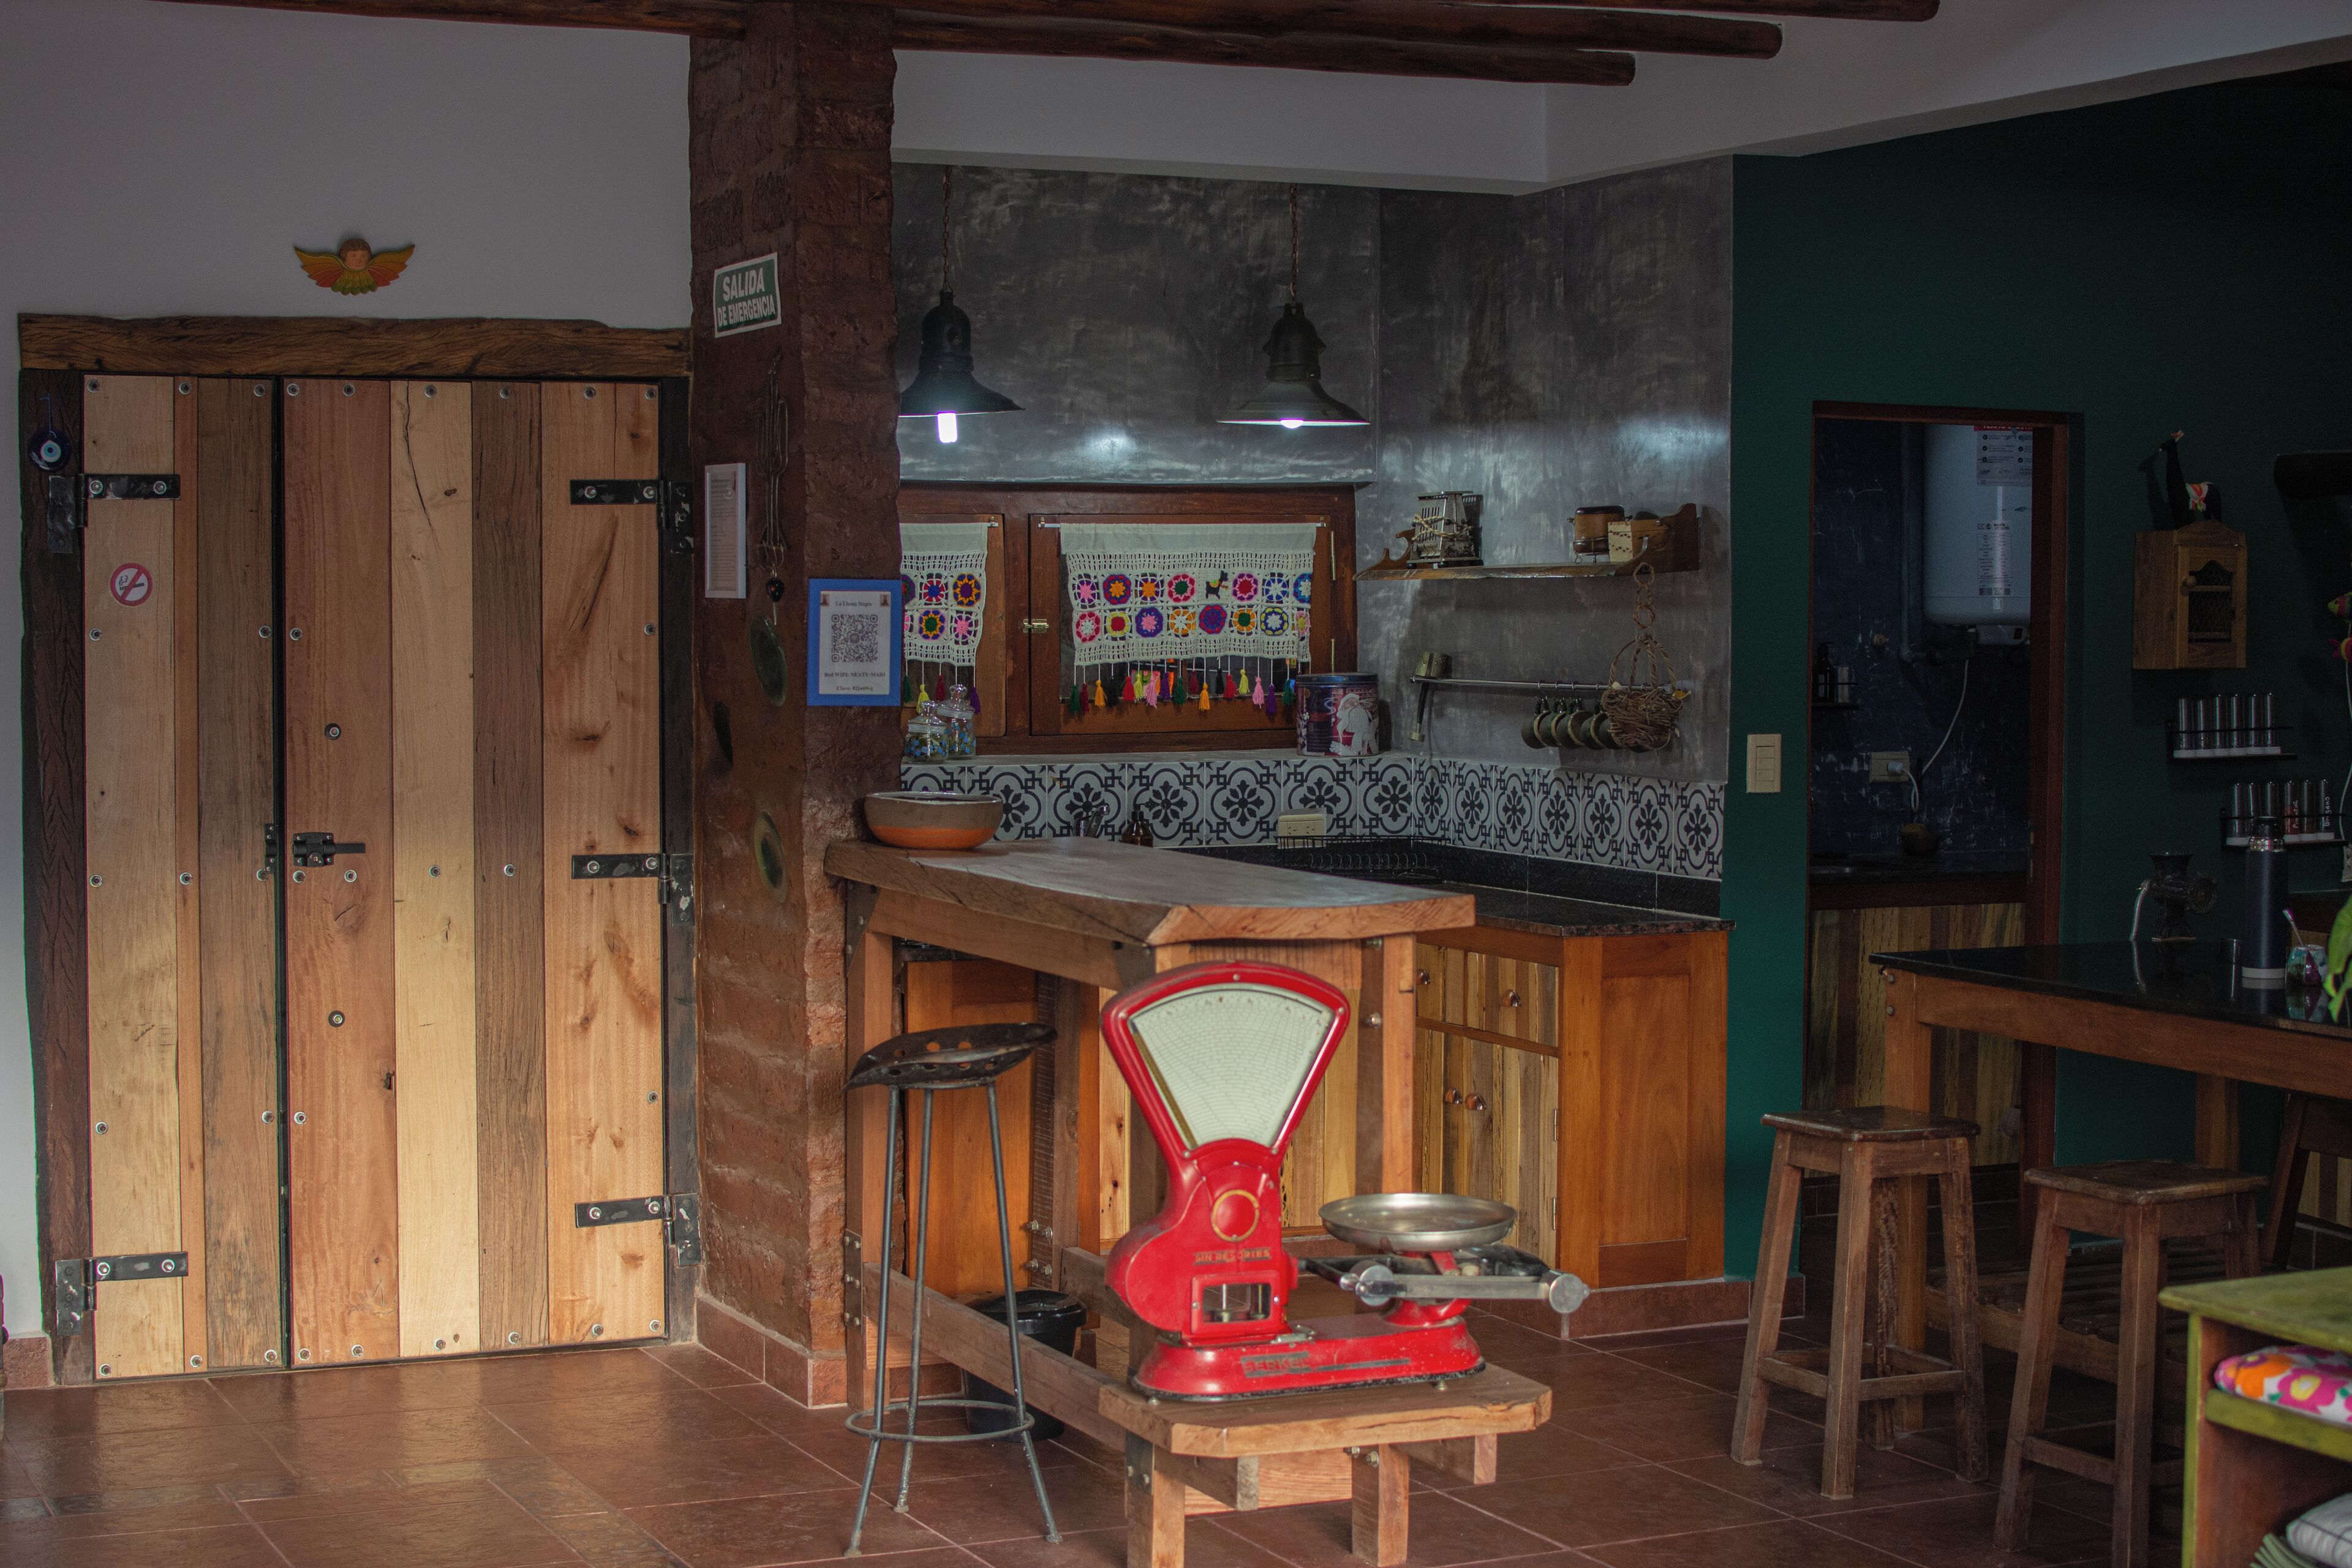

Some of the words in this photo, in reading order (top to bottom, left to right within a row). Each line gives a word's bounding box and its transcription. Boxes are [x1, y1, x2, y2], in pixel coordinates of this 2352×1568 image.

[723, 267, 765, 302] SALIDA
[717, 306, 728, 327] DE
[728, 295, 776, 325] EMERGENCIA
[1196, 1254, 1212, 1263] SIN
